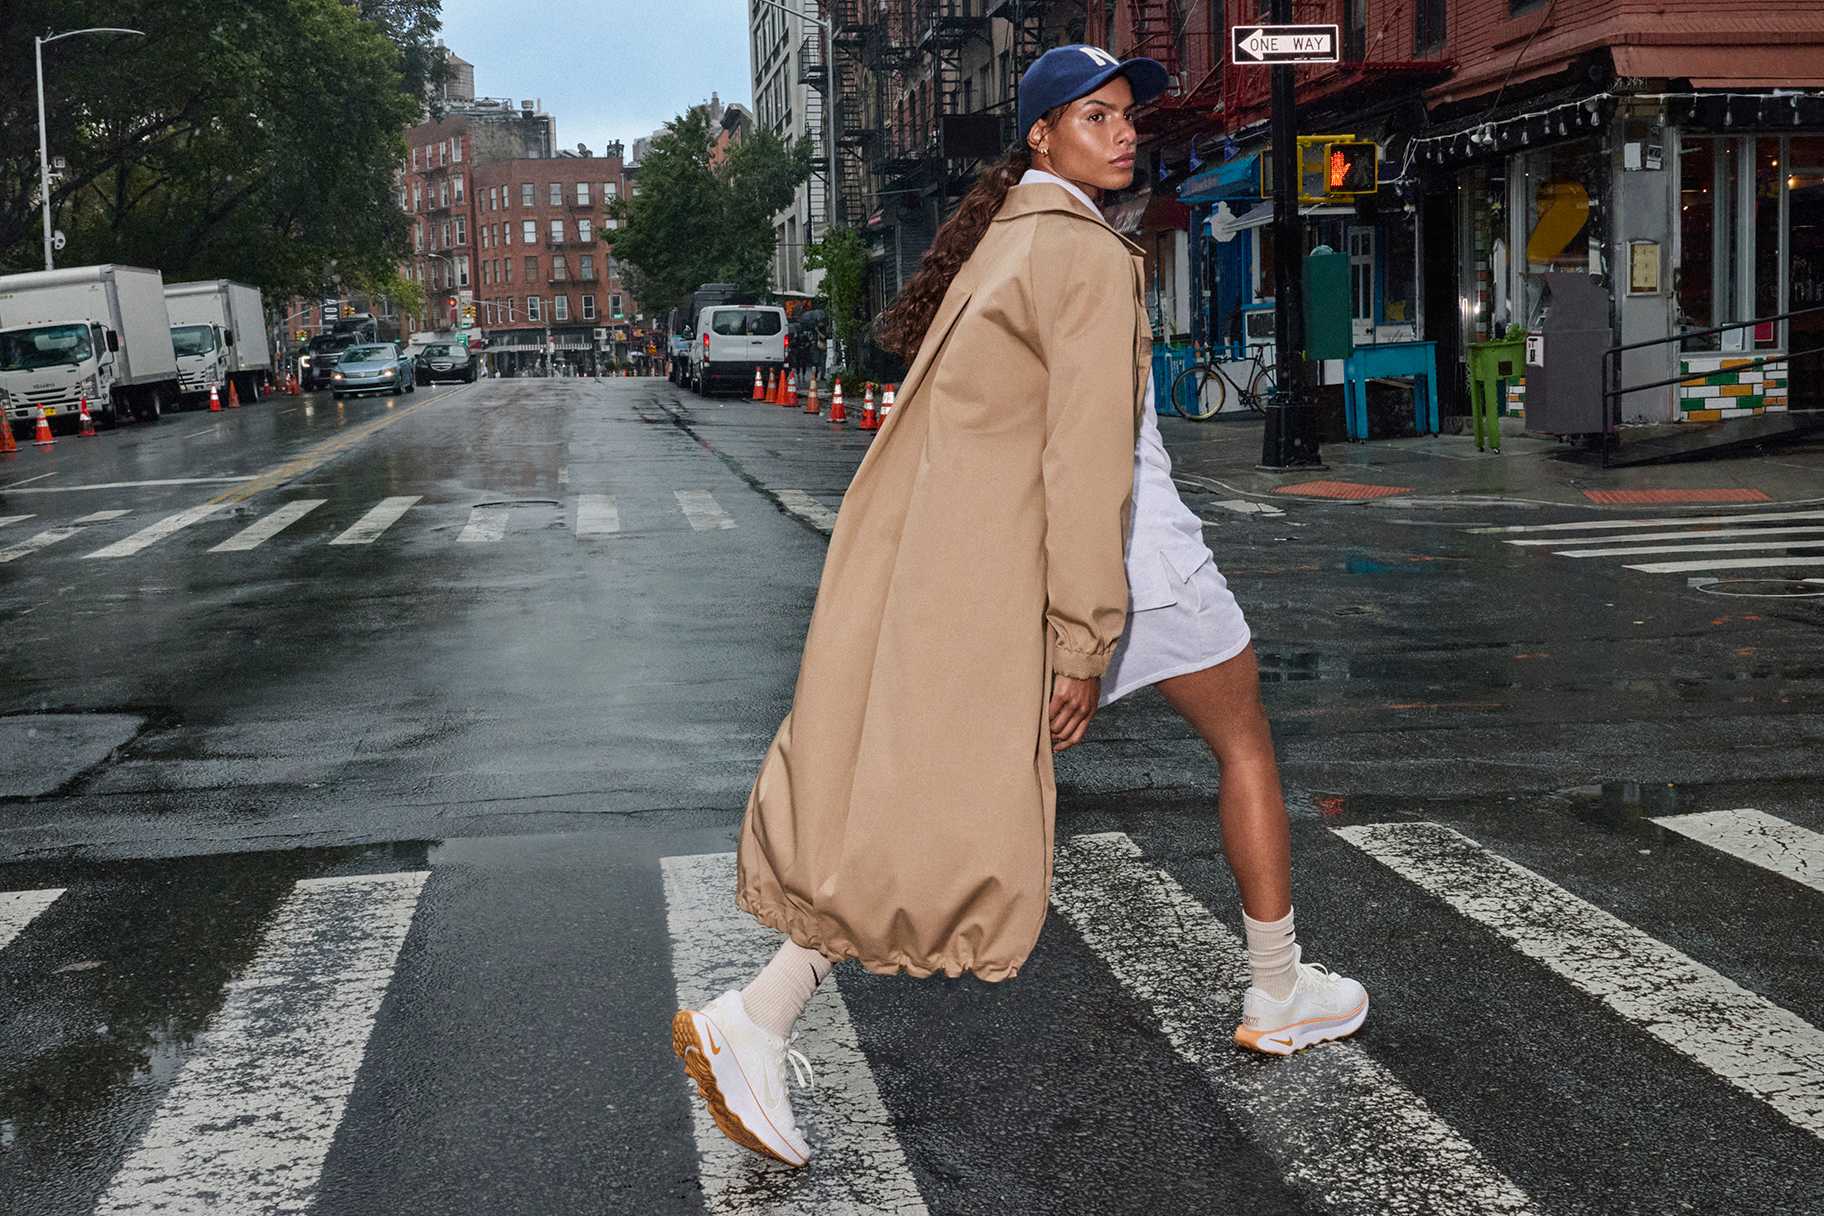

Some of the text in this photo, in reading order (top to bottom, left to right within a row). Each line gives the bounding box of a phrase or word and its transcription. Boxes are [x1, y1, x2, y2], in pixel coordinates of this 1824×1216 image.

[1250, 37, 1323, 51] ONE WAY
[1079, 47, 1119, 66] N
